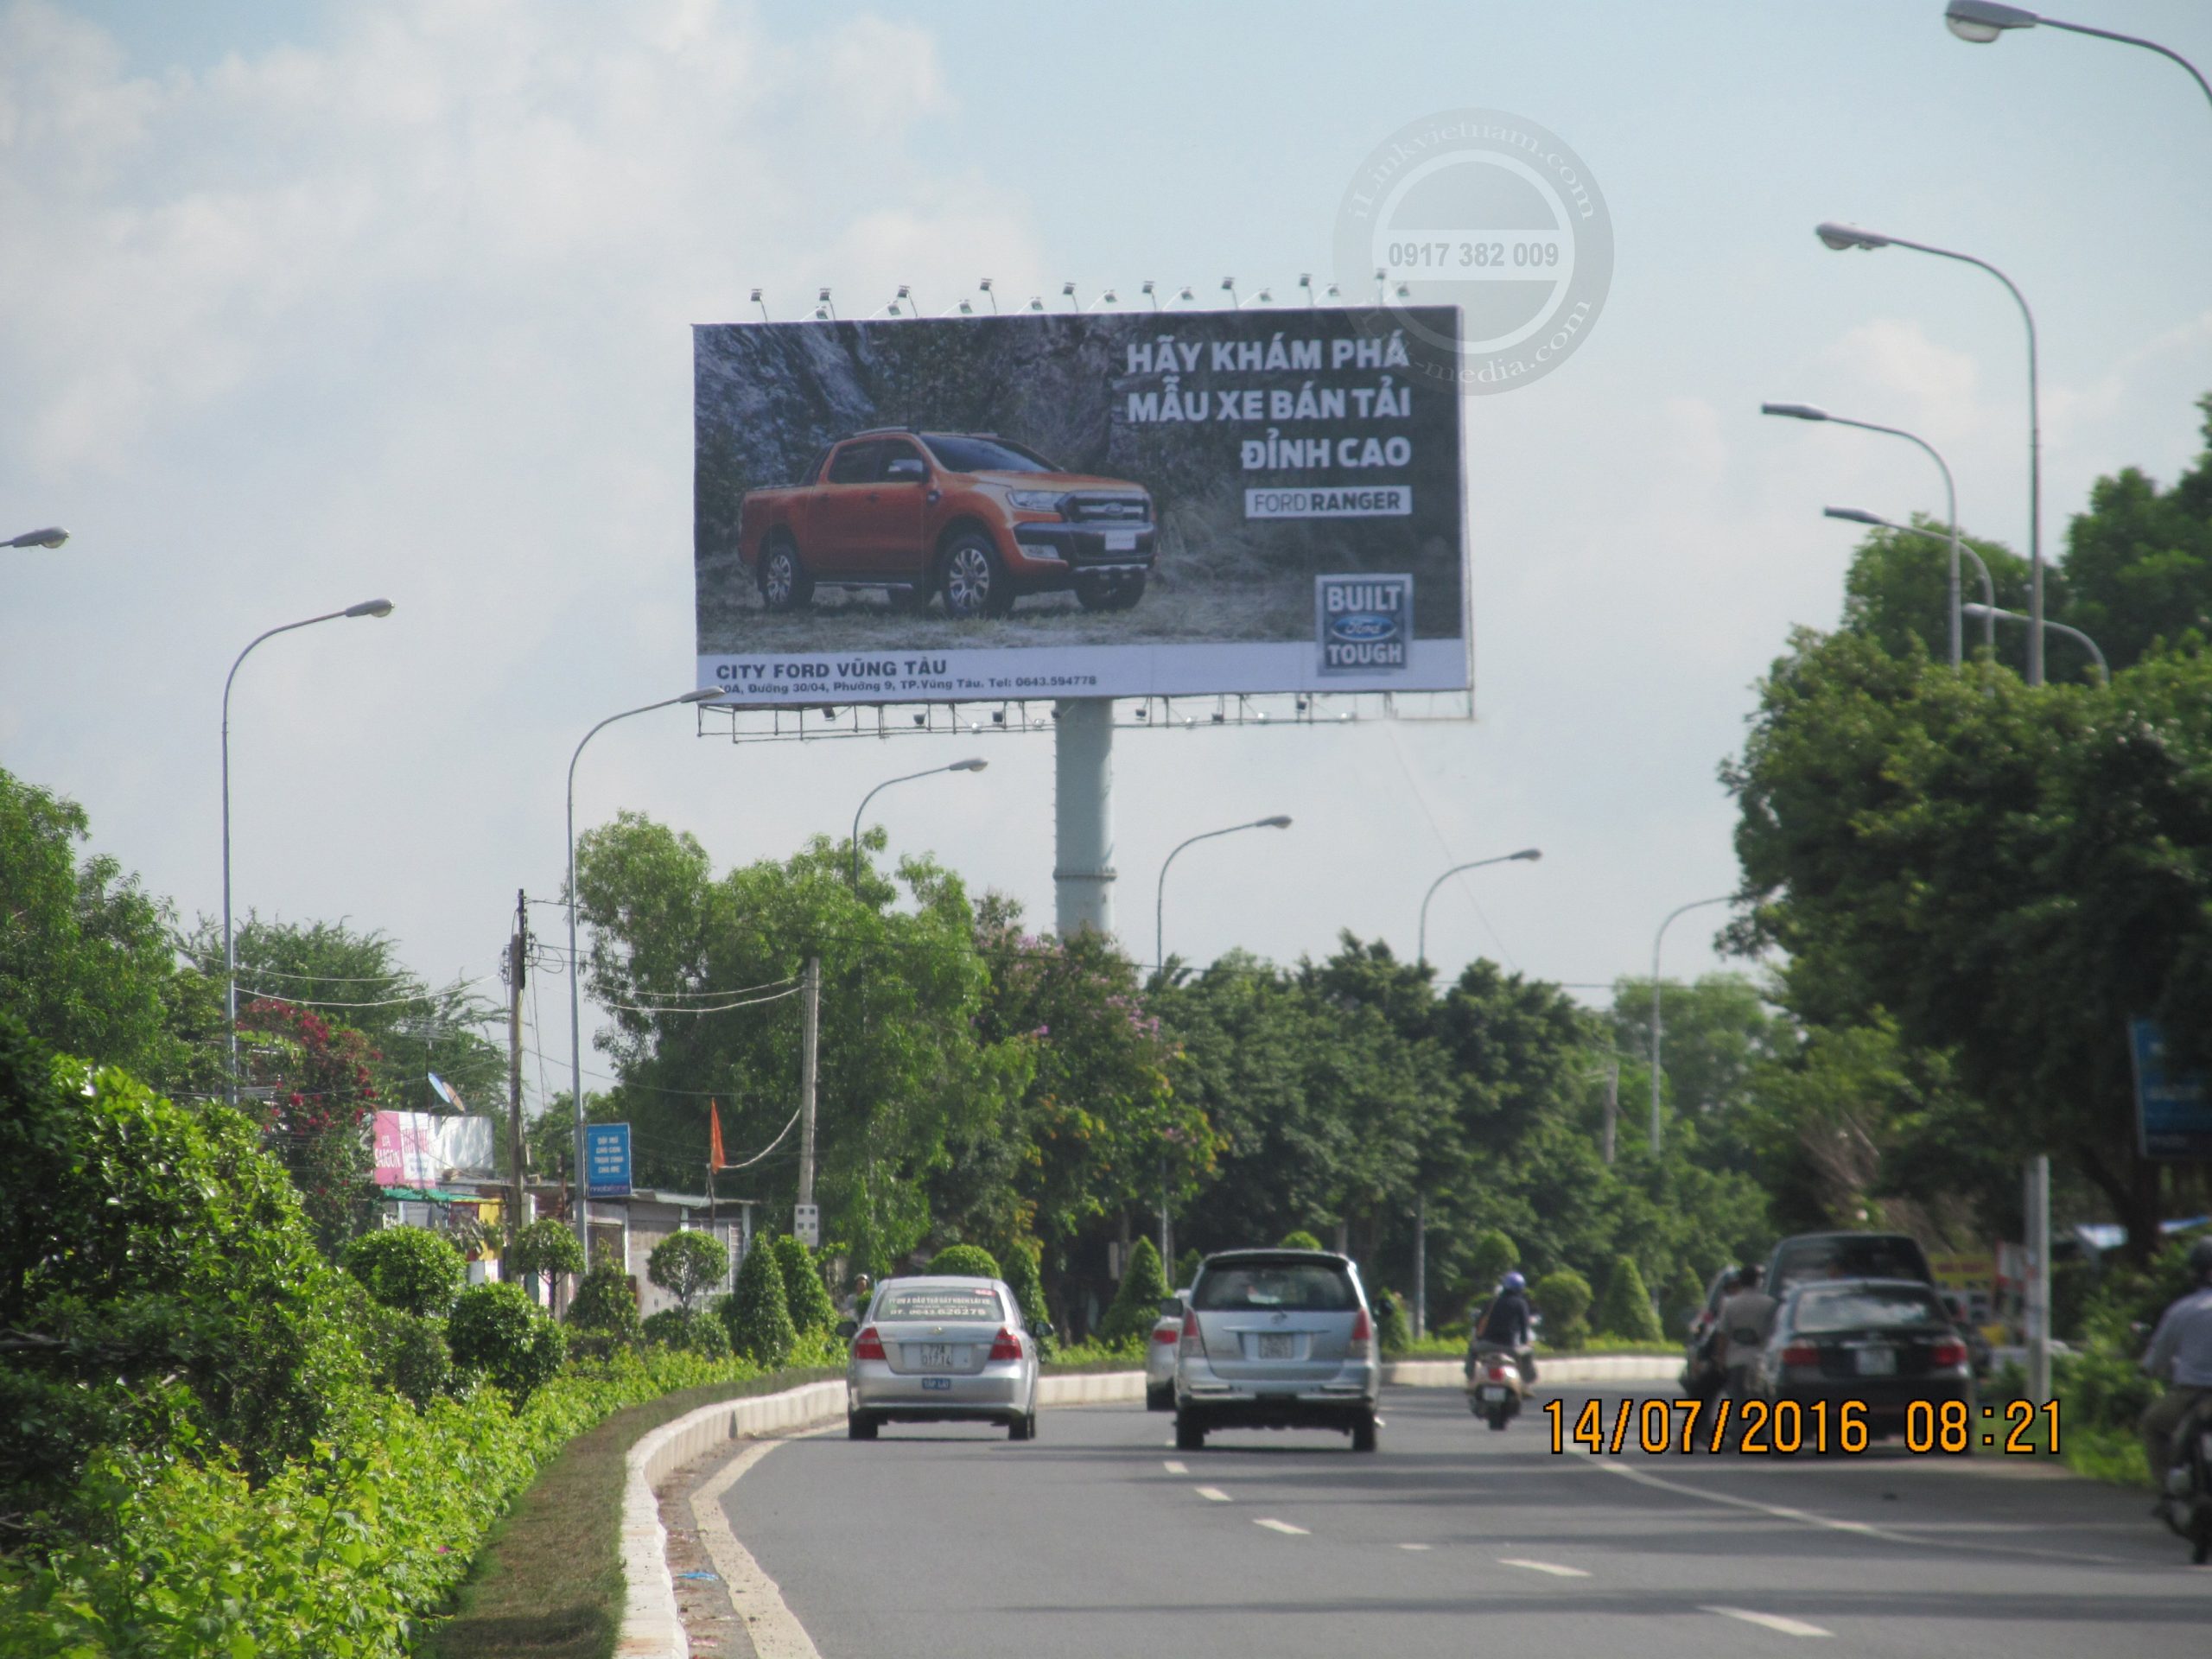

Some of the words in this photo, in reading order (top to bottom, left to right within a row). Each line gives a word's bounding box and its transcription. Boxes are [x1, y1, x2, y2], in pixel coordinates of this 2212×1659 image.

[1127, 334, 1203, 373] HÃY
[1212, 332, 1322, 372] KHÁM
[1332, 328, 1409, 369] PHÁ
[1128, 376, 1209, 423] MẪU
[1217, 391, 1264, 421] XE
[1271, 381, 1345, 420] BÁN
[1351, 376, 1411, 418] TẢI
[1241, 428, 1331, 469] ĐỈNH
[1338, 436, 1412, 467] CAO
[1254, 493, 1310, 513] FORD
[1311, 491, 1401, 512] RANGER
[1326, 585, 1402, 612] BUILT
[1344, 620, 1382, 638] Ford
[1328, 643, 1403, 665] TOUGH
[715, 663, 766, 680] CITY
[773, 663, 830, 679] FORD
[836, 658, 897, 677] VŨNG
[904, 656, 947, 675] TÀU
[792, 683, 830, 693] 30/04,
[884, 680, 896, 690] 9,
[988, 677, 1012, 688] Tel:
[1015, 675, 1096, 687] 0643.594778
